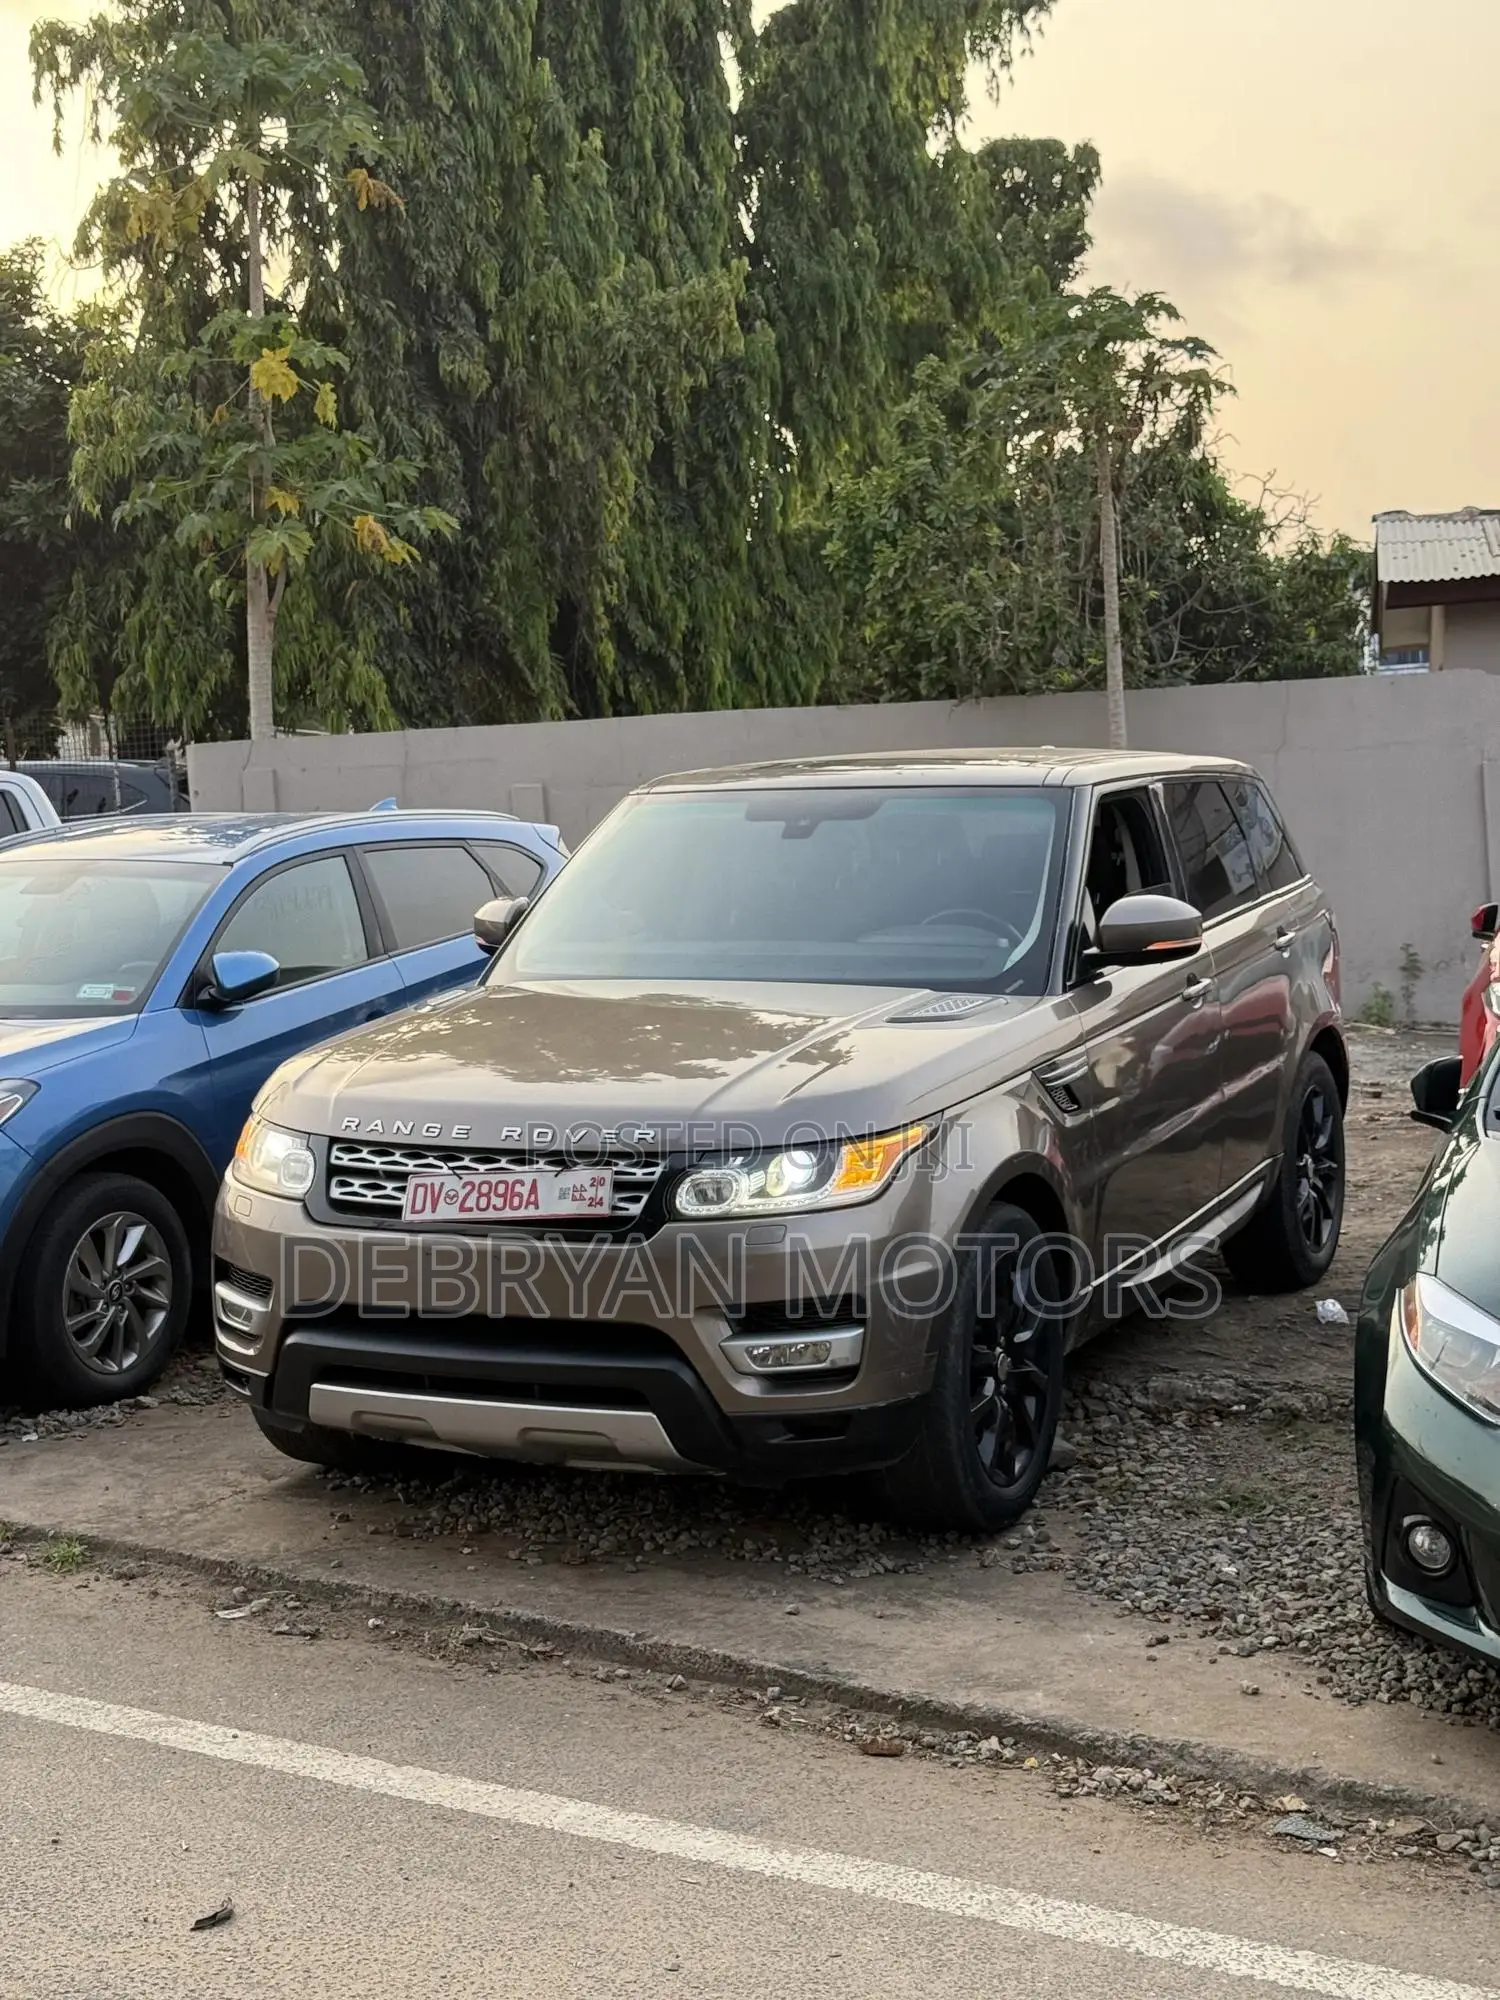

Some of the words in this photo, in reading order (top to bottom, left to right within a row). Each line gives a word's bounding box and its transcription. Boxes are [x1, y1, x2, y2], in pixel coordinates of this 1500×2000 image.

[340, 1116, 473, 1139] RANGE
[499, 1125, 656, 1144] ROVER
[410, 1181, 445, 1215] DV
[458, 1178, 540, 1213] 2896A
